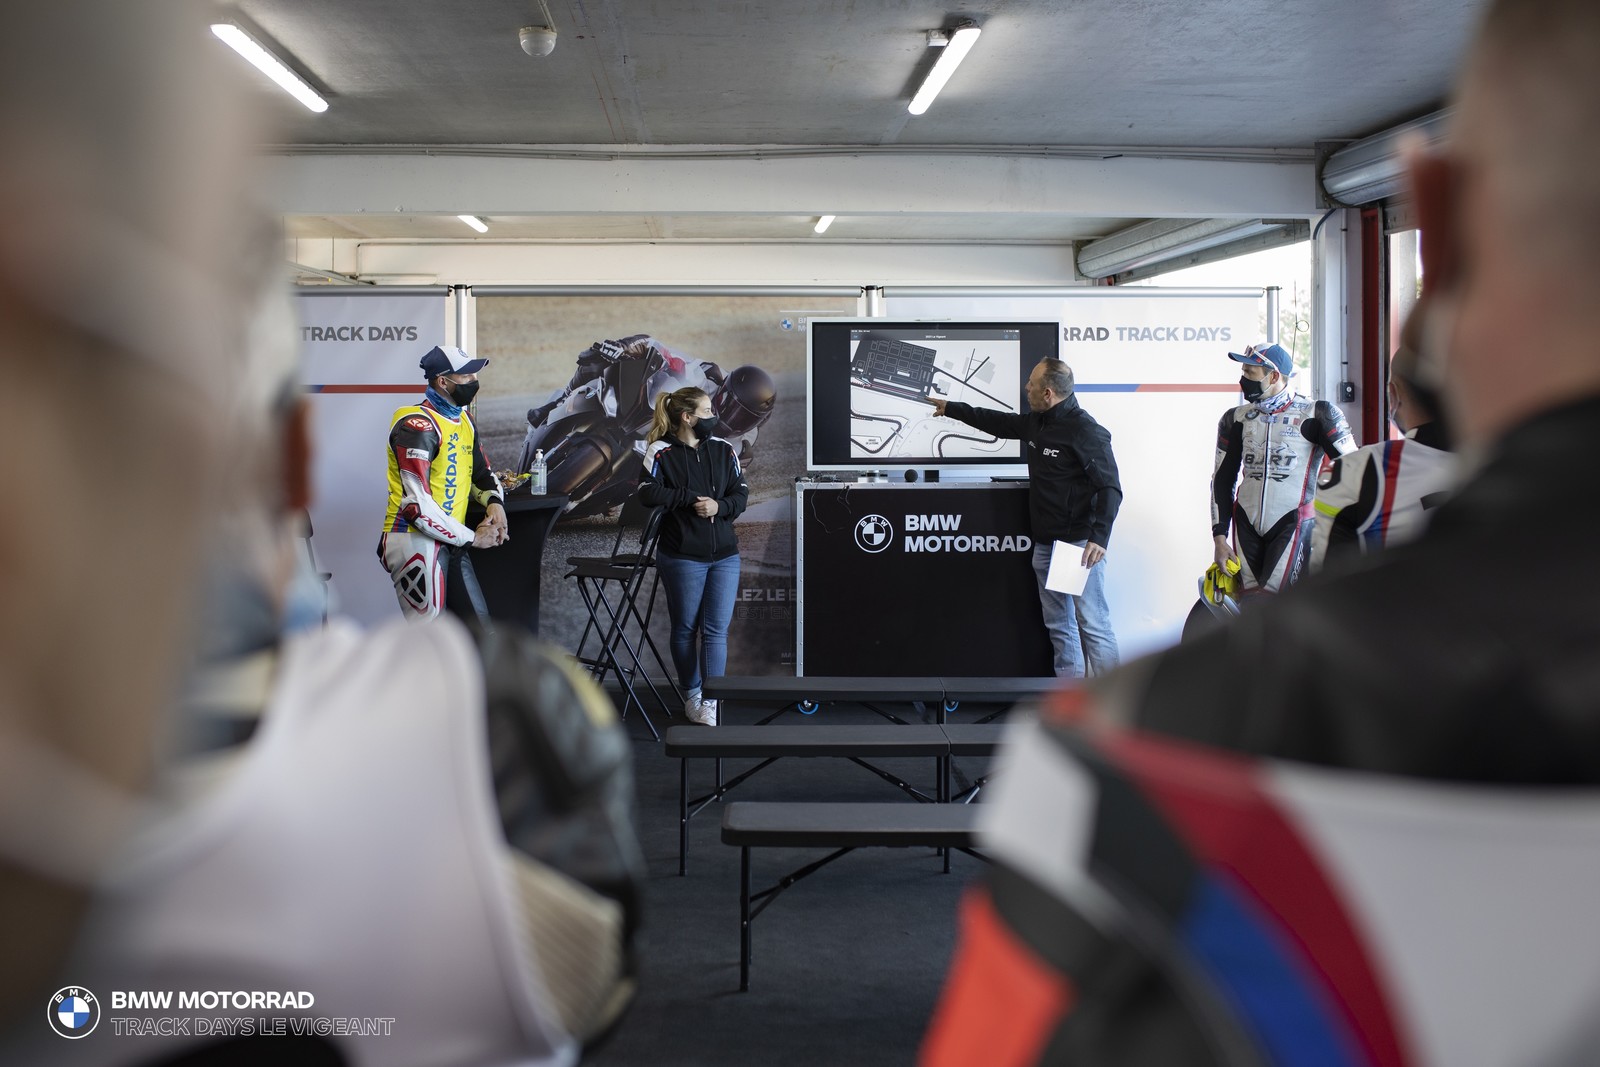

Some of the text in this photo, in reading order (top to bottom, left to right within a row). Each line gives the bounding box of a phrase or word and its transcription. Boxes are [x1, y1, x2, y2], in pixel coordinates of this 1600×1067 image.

[301, 326, 418, 342] TRACK DAYS
[1115, 326, 1179, 342] TRACK
[1183, 326, 1232, 342] DAYS
[904, 514, 962, 532] BMW
[904, 535, 1032, 553] MOTORRAD
[766, 588, 786, 602] LE
